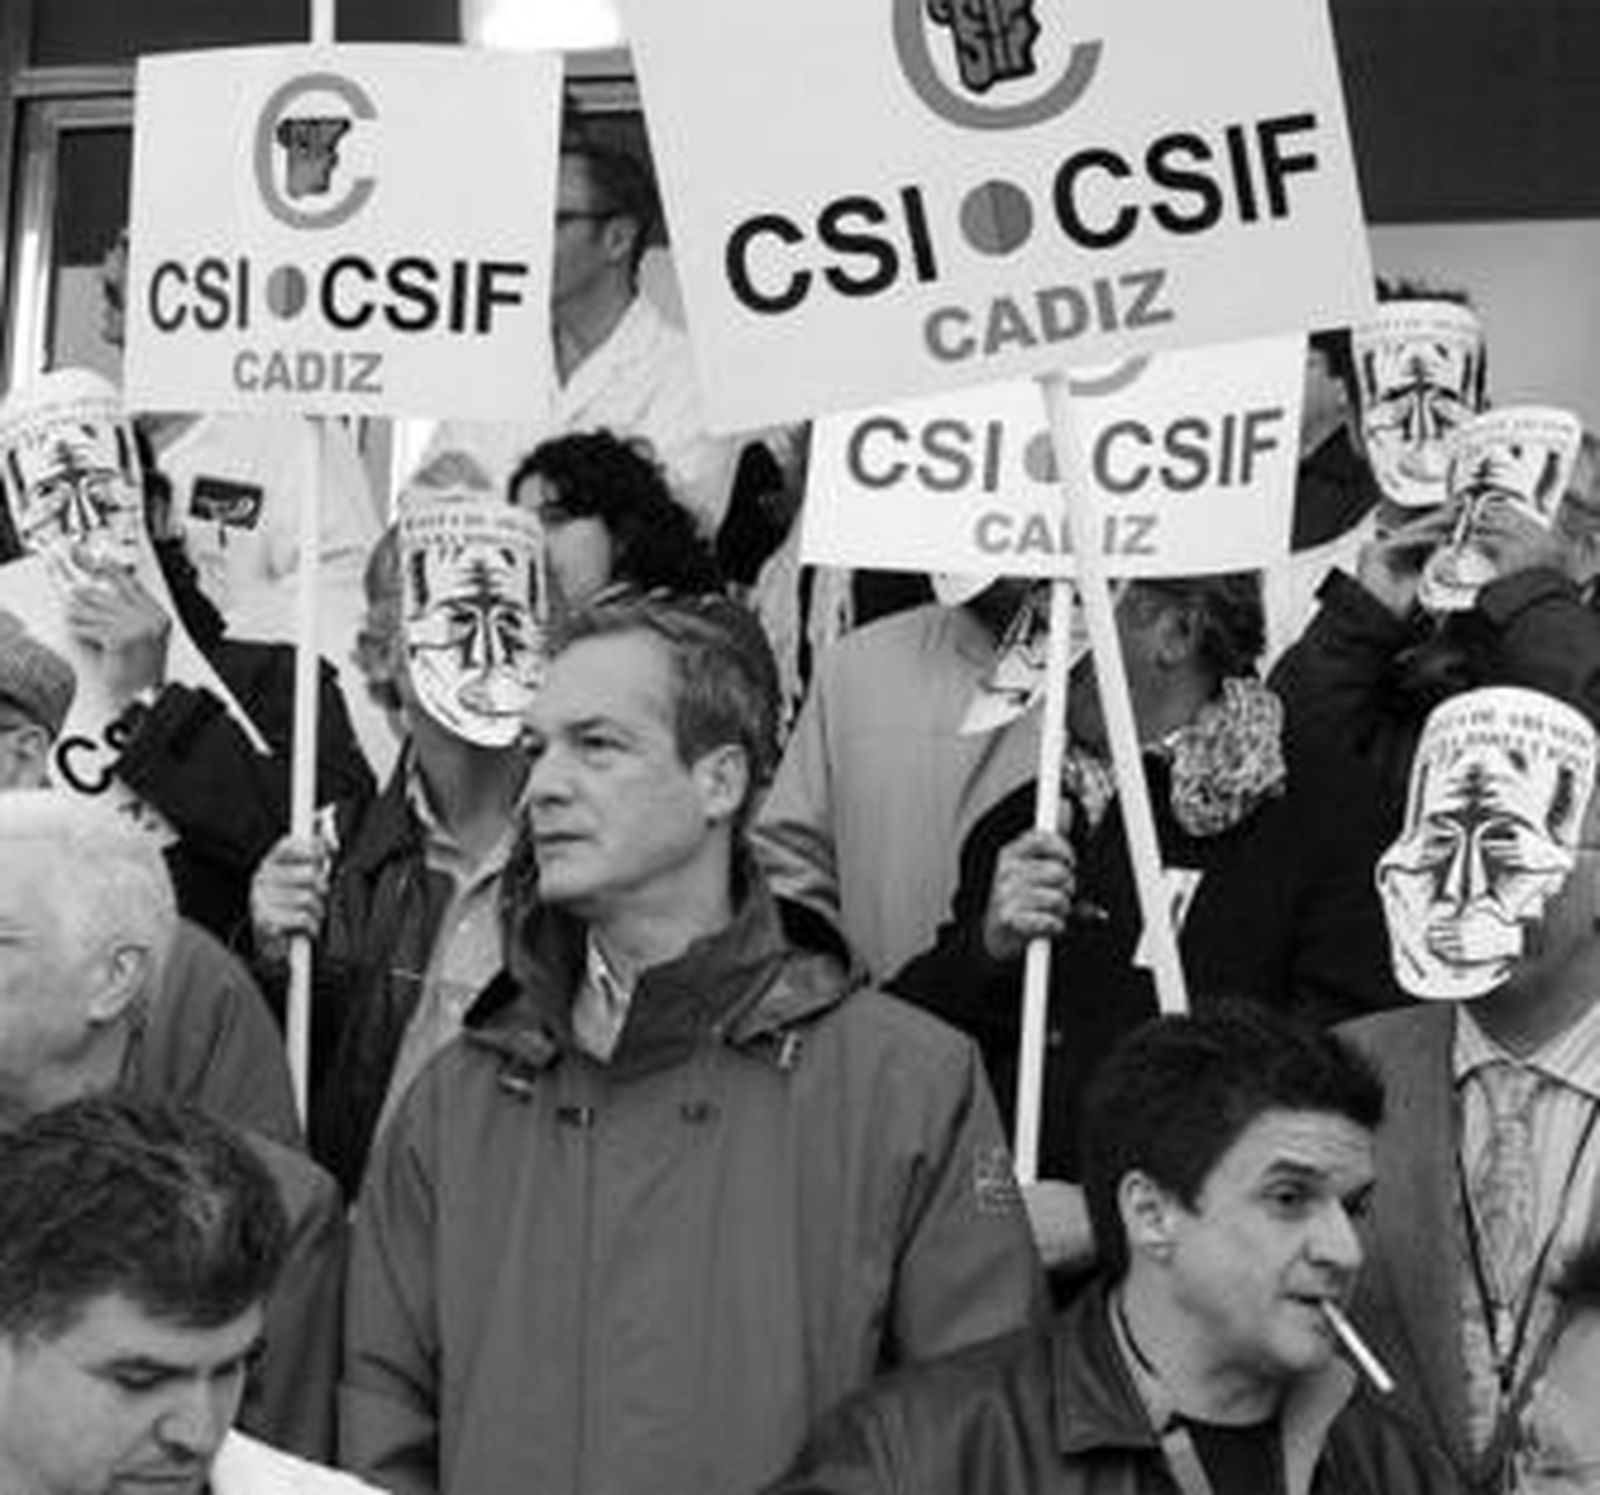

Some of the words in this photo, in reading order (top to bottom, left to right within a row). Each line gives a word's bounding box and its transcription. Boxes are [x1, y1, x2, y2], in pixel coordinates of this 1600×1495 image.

[725, 185, 938, 315] CSI
[1052, 112, 1319, 250] CSIF
[148, 257, 250, 333] CSI
[319, 255, 529, 335] CSIF
[923, 267, 1176, 363] CADIZ
[232, 350, 384, 394] CADIZ
[846, 415, 1003, 493] CSI
[1092, 407, 1285, 496] CSIF
